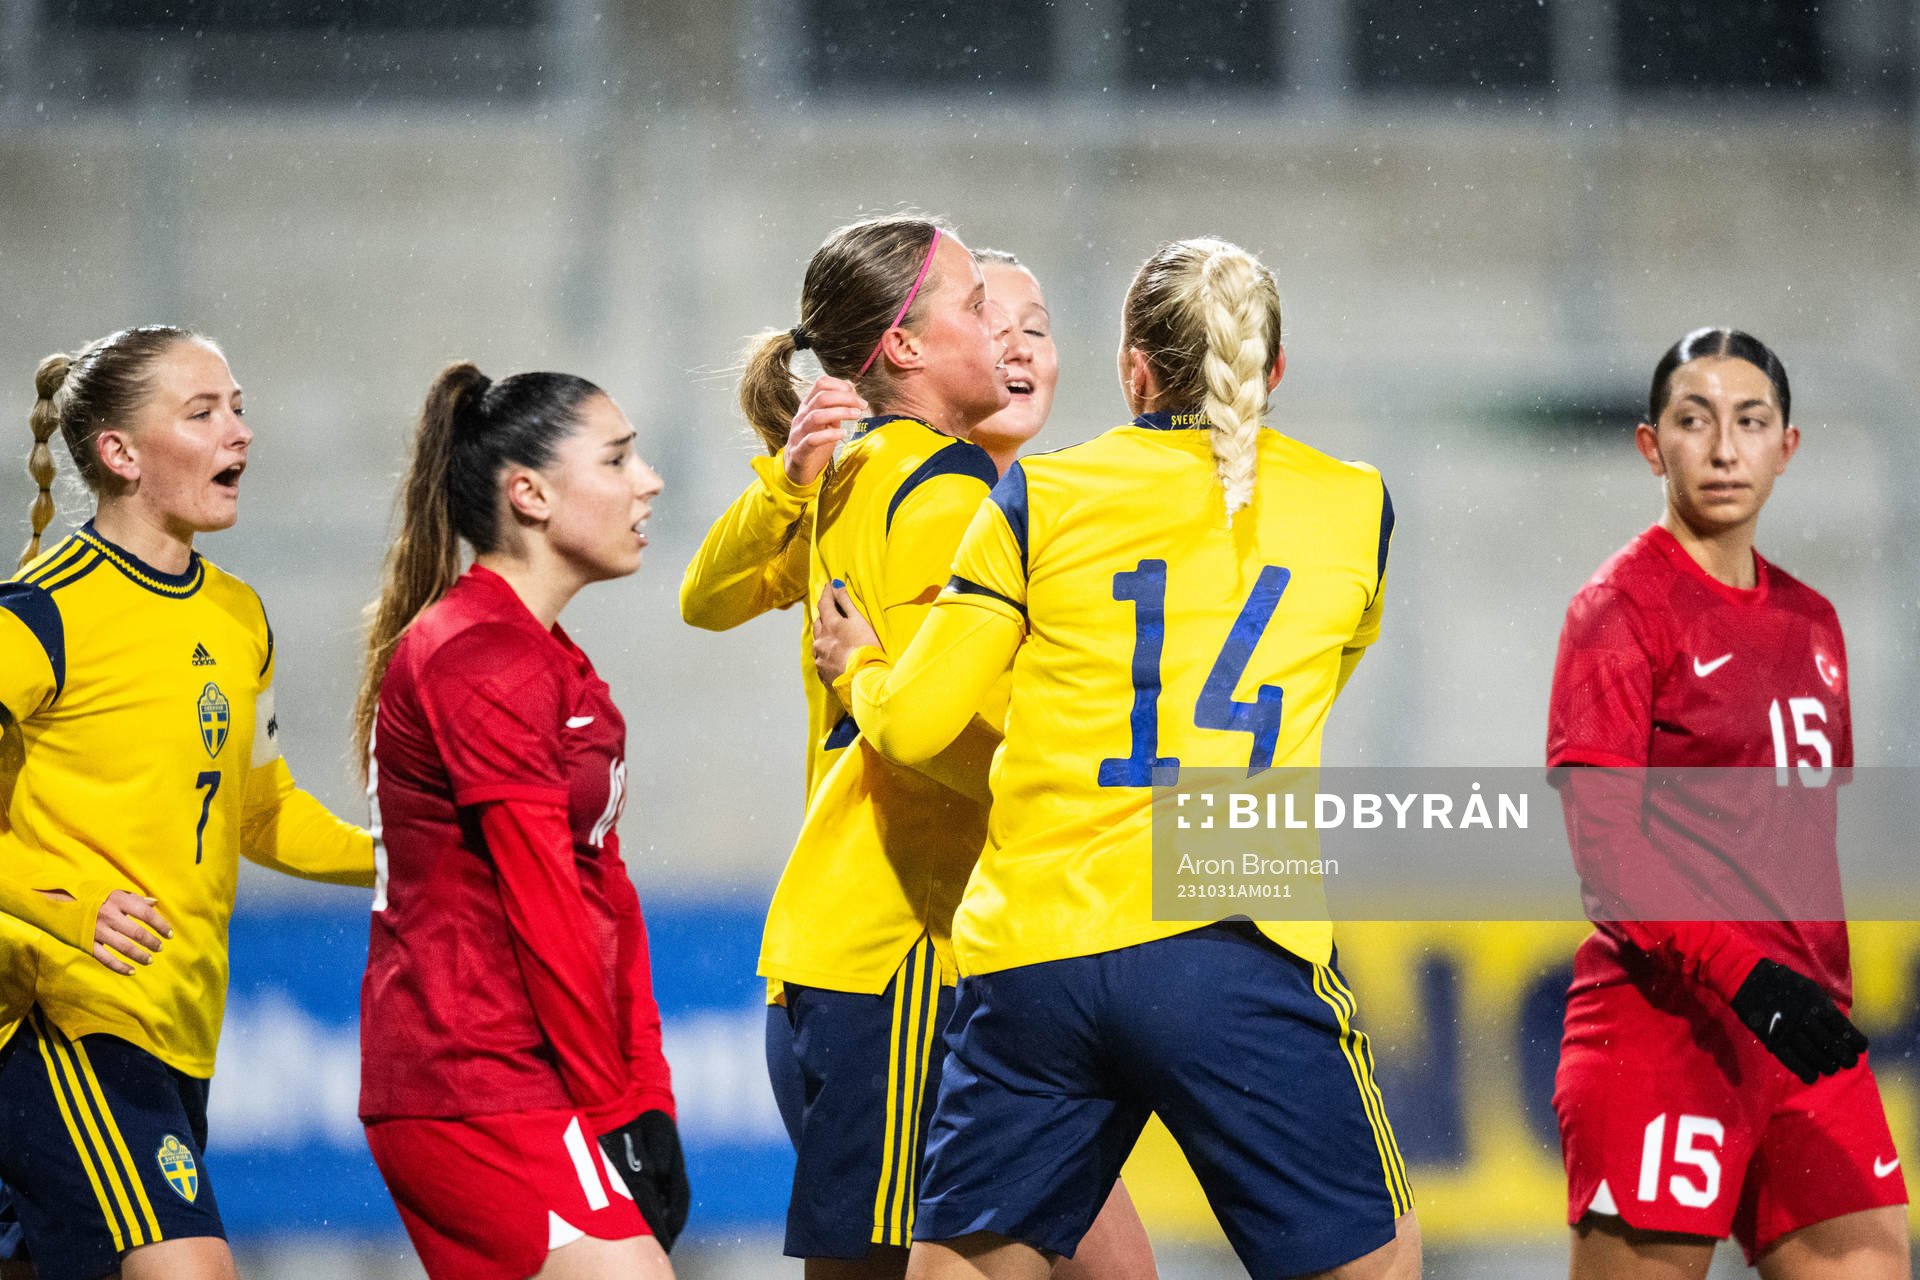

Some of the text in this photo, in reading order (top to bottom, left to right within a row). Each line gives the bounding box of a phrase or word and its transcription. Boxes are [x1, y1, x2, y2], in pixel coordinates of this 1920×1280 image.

[192, 657, 216, 666] adidas
[1098, 559, 1291, 787] 14
[1769, 697, 1832, 788] 15
[195, 771, 221, 865] 7
[1637, 1112, 1724, 1209] 15
